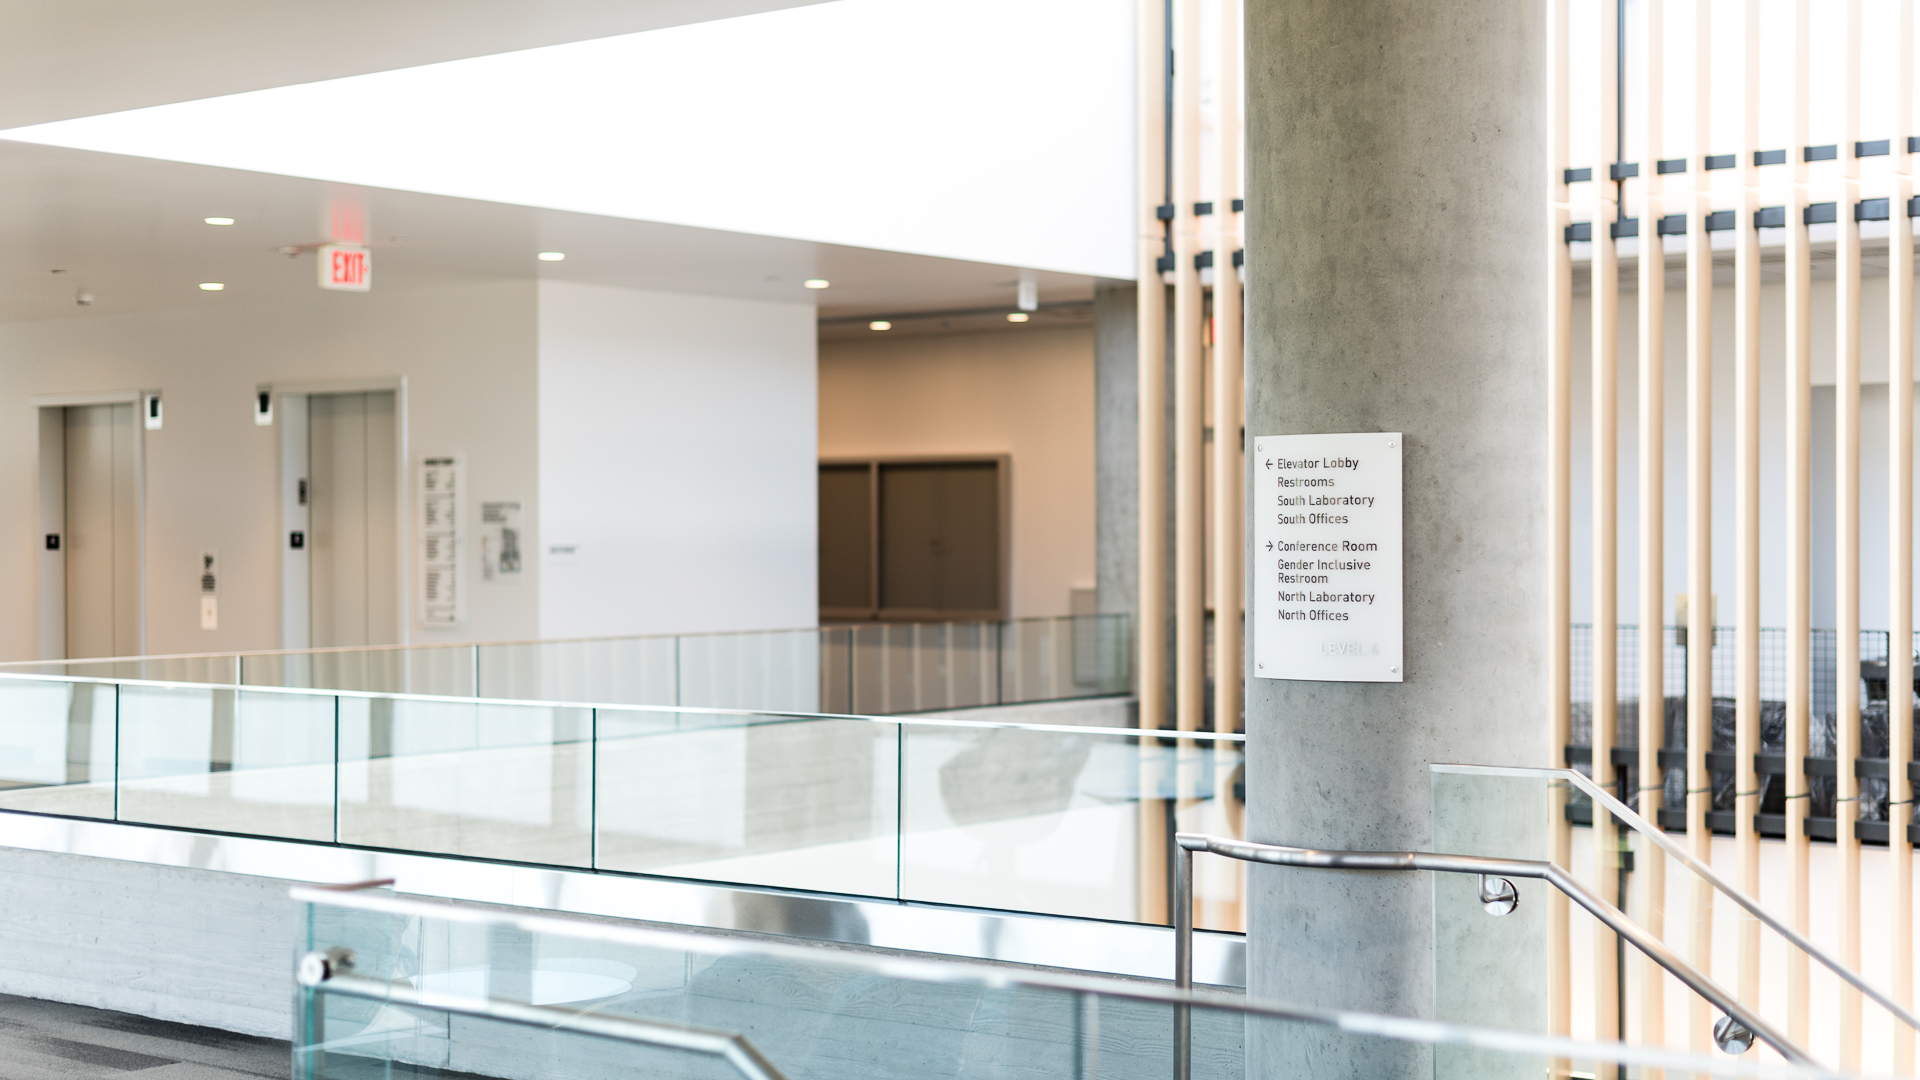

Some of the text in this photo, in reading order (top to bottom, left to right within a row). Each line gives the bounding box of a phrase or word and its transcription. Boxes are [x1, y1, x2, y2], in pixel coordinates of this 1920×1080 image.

[332, 250, 365, 286] EXIT
[1277, 457, 1359, 470] Elevator Lobby
[1277, 476, 1335, 488] Restrooms
[1277, 494, 1375, 507] South Laboratory
[1277, 512, 1349, 525] South Offices
[1277, 540, 1378, 552] Conference Room
[1277, 559, 1371, 570] Gender Inclusive
[1277, 572, 1329, 584] Restroom
[1277, 591, 1375, 605] North Laboratory
[1277, 609, 1349, 621] North Offices
[1320, 641, 1367, 656] LEVEL
